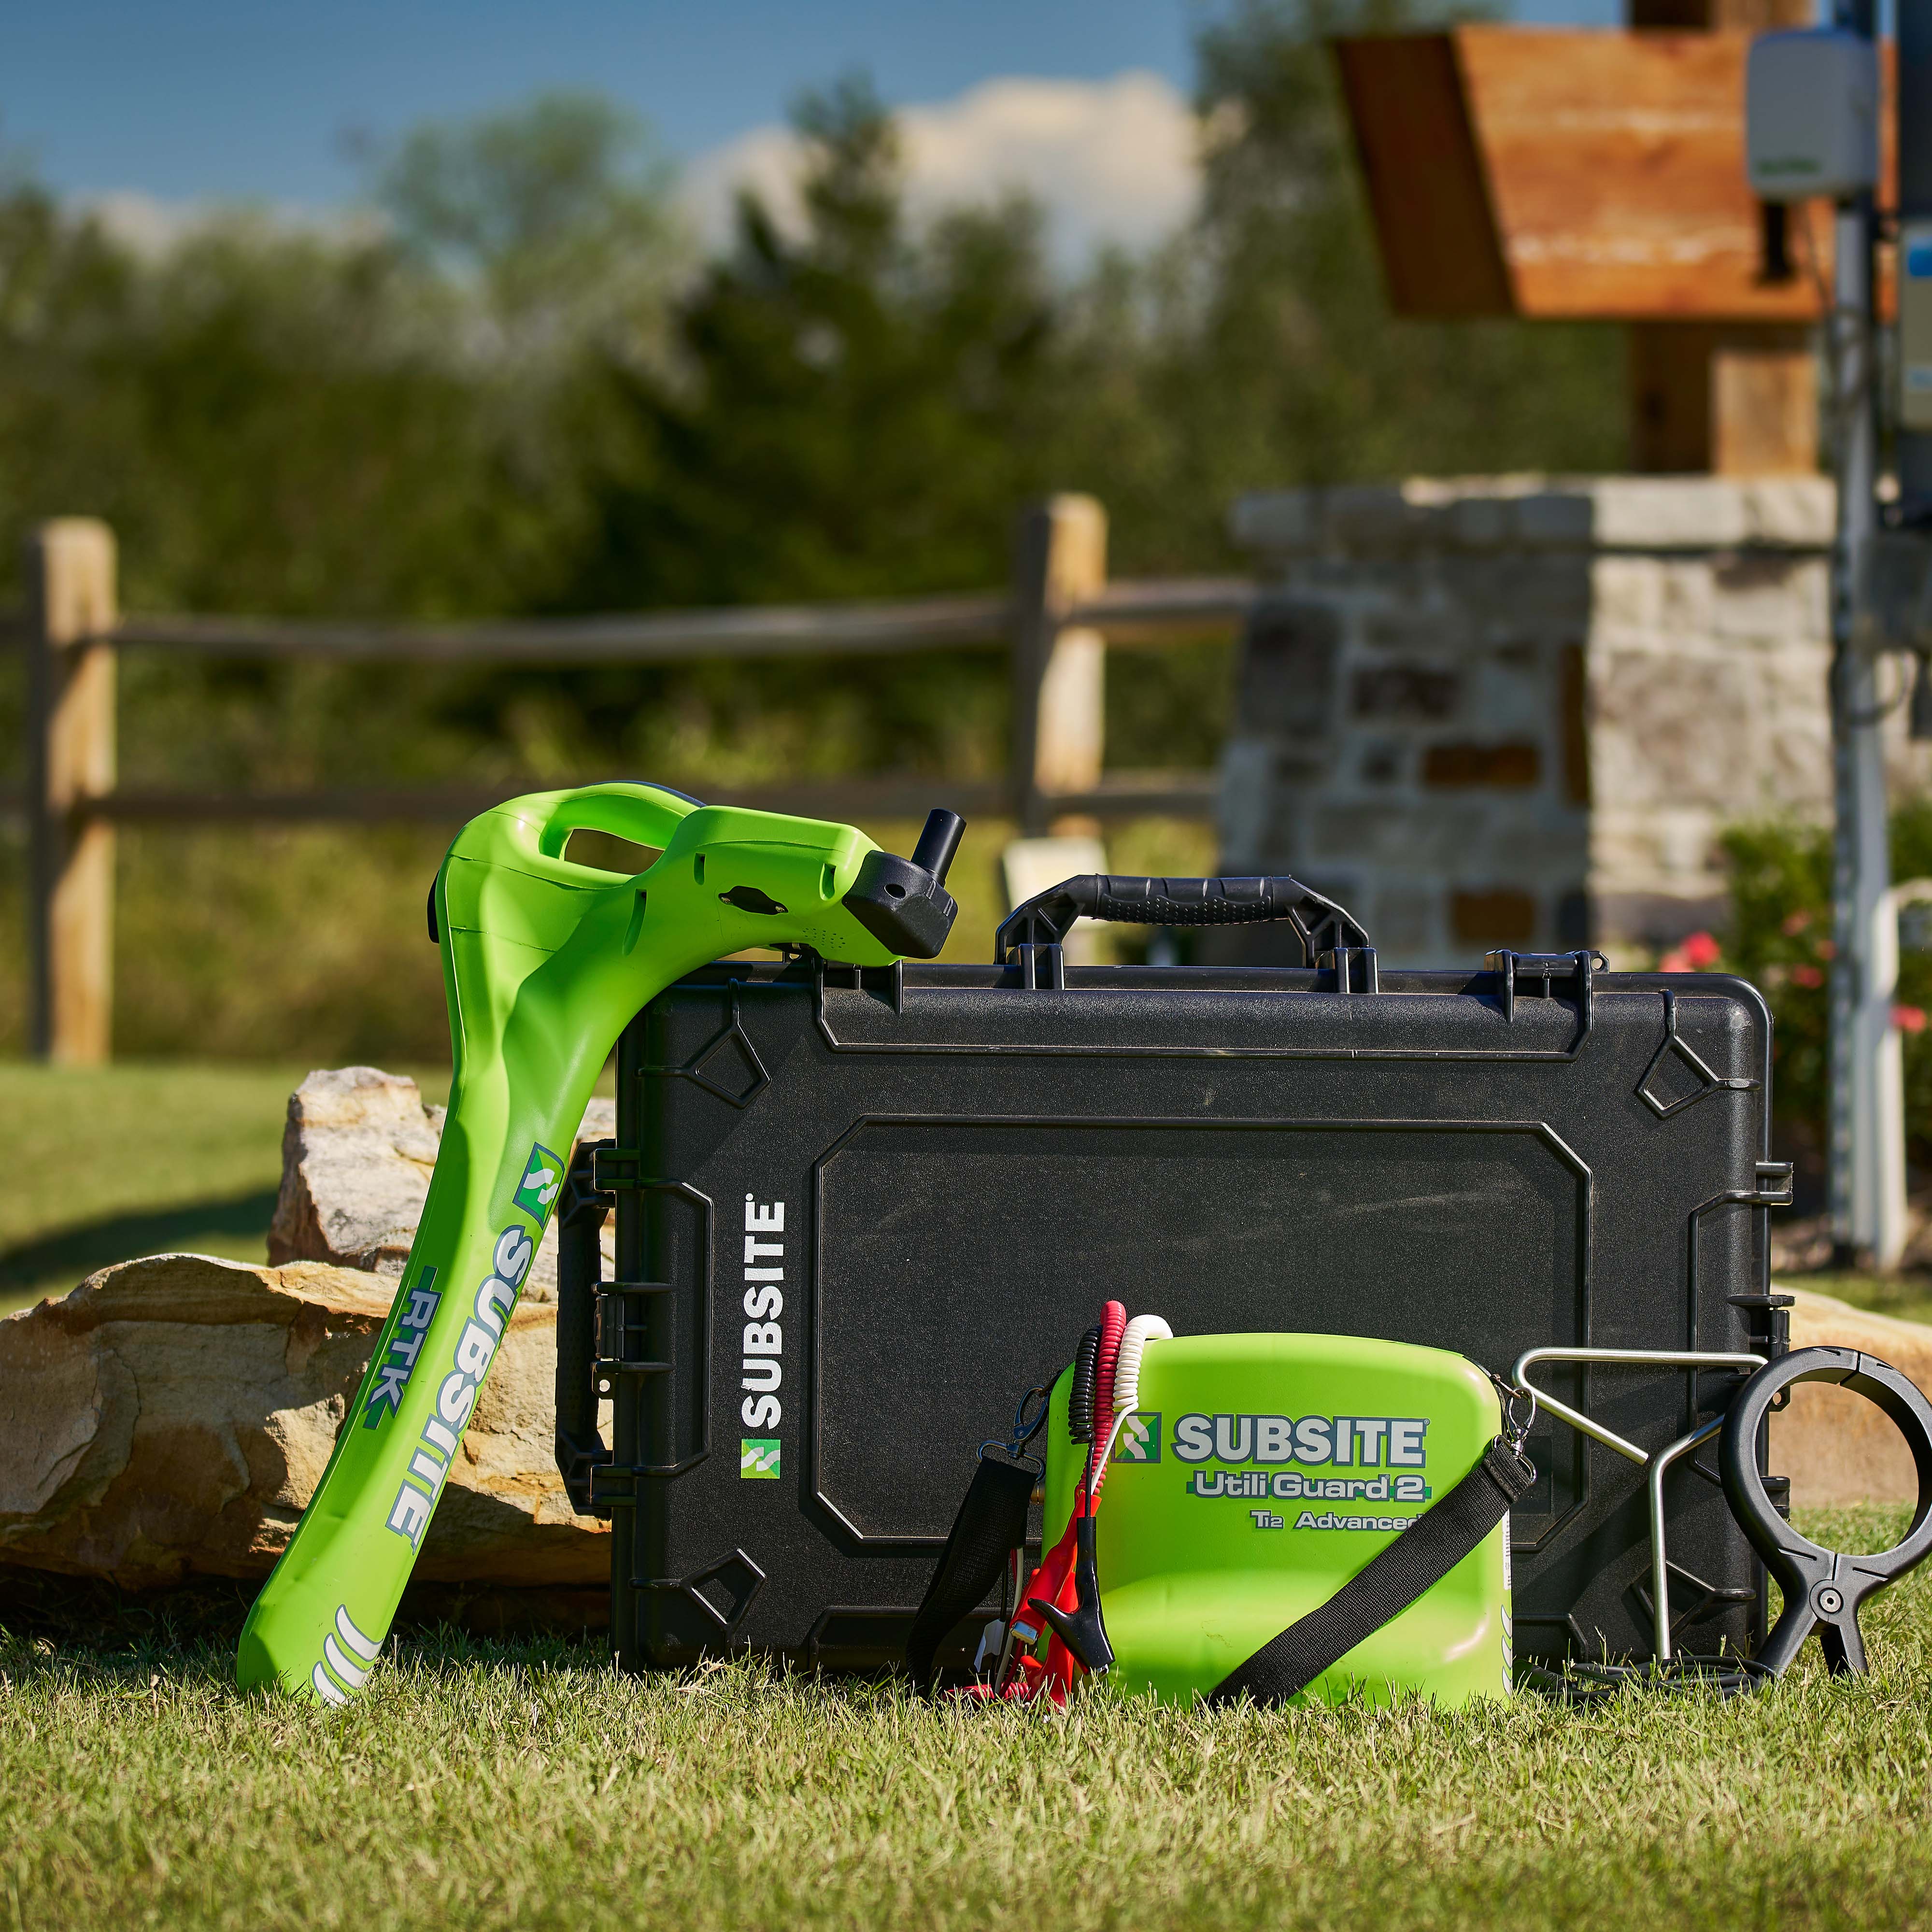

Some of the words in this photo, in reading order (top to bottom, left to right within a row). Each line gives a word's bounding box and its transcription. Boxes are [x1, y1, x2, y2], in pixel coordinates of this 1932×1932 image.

[369, 1289, 440, 1409] RTK
[389, 1227, 531, 1547] SUBSITE
[740, 1201, 785, 1430] SUBSITE
[1395, 1476, 1424, 1501] 2
